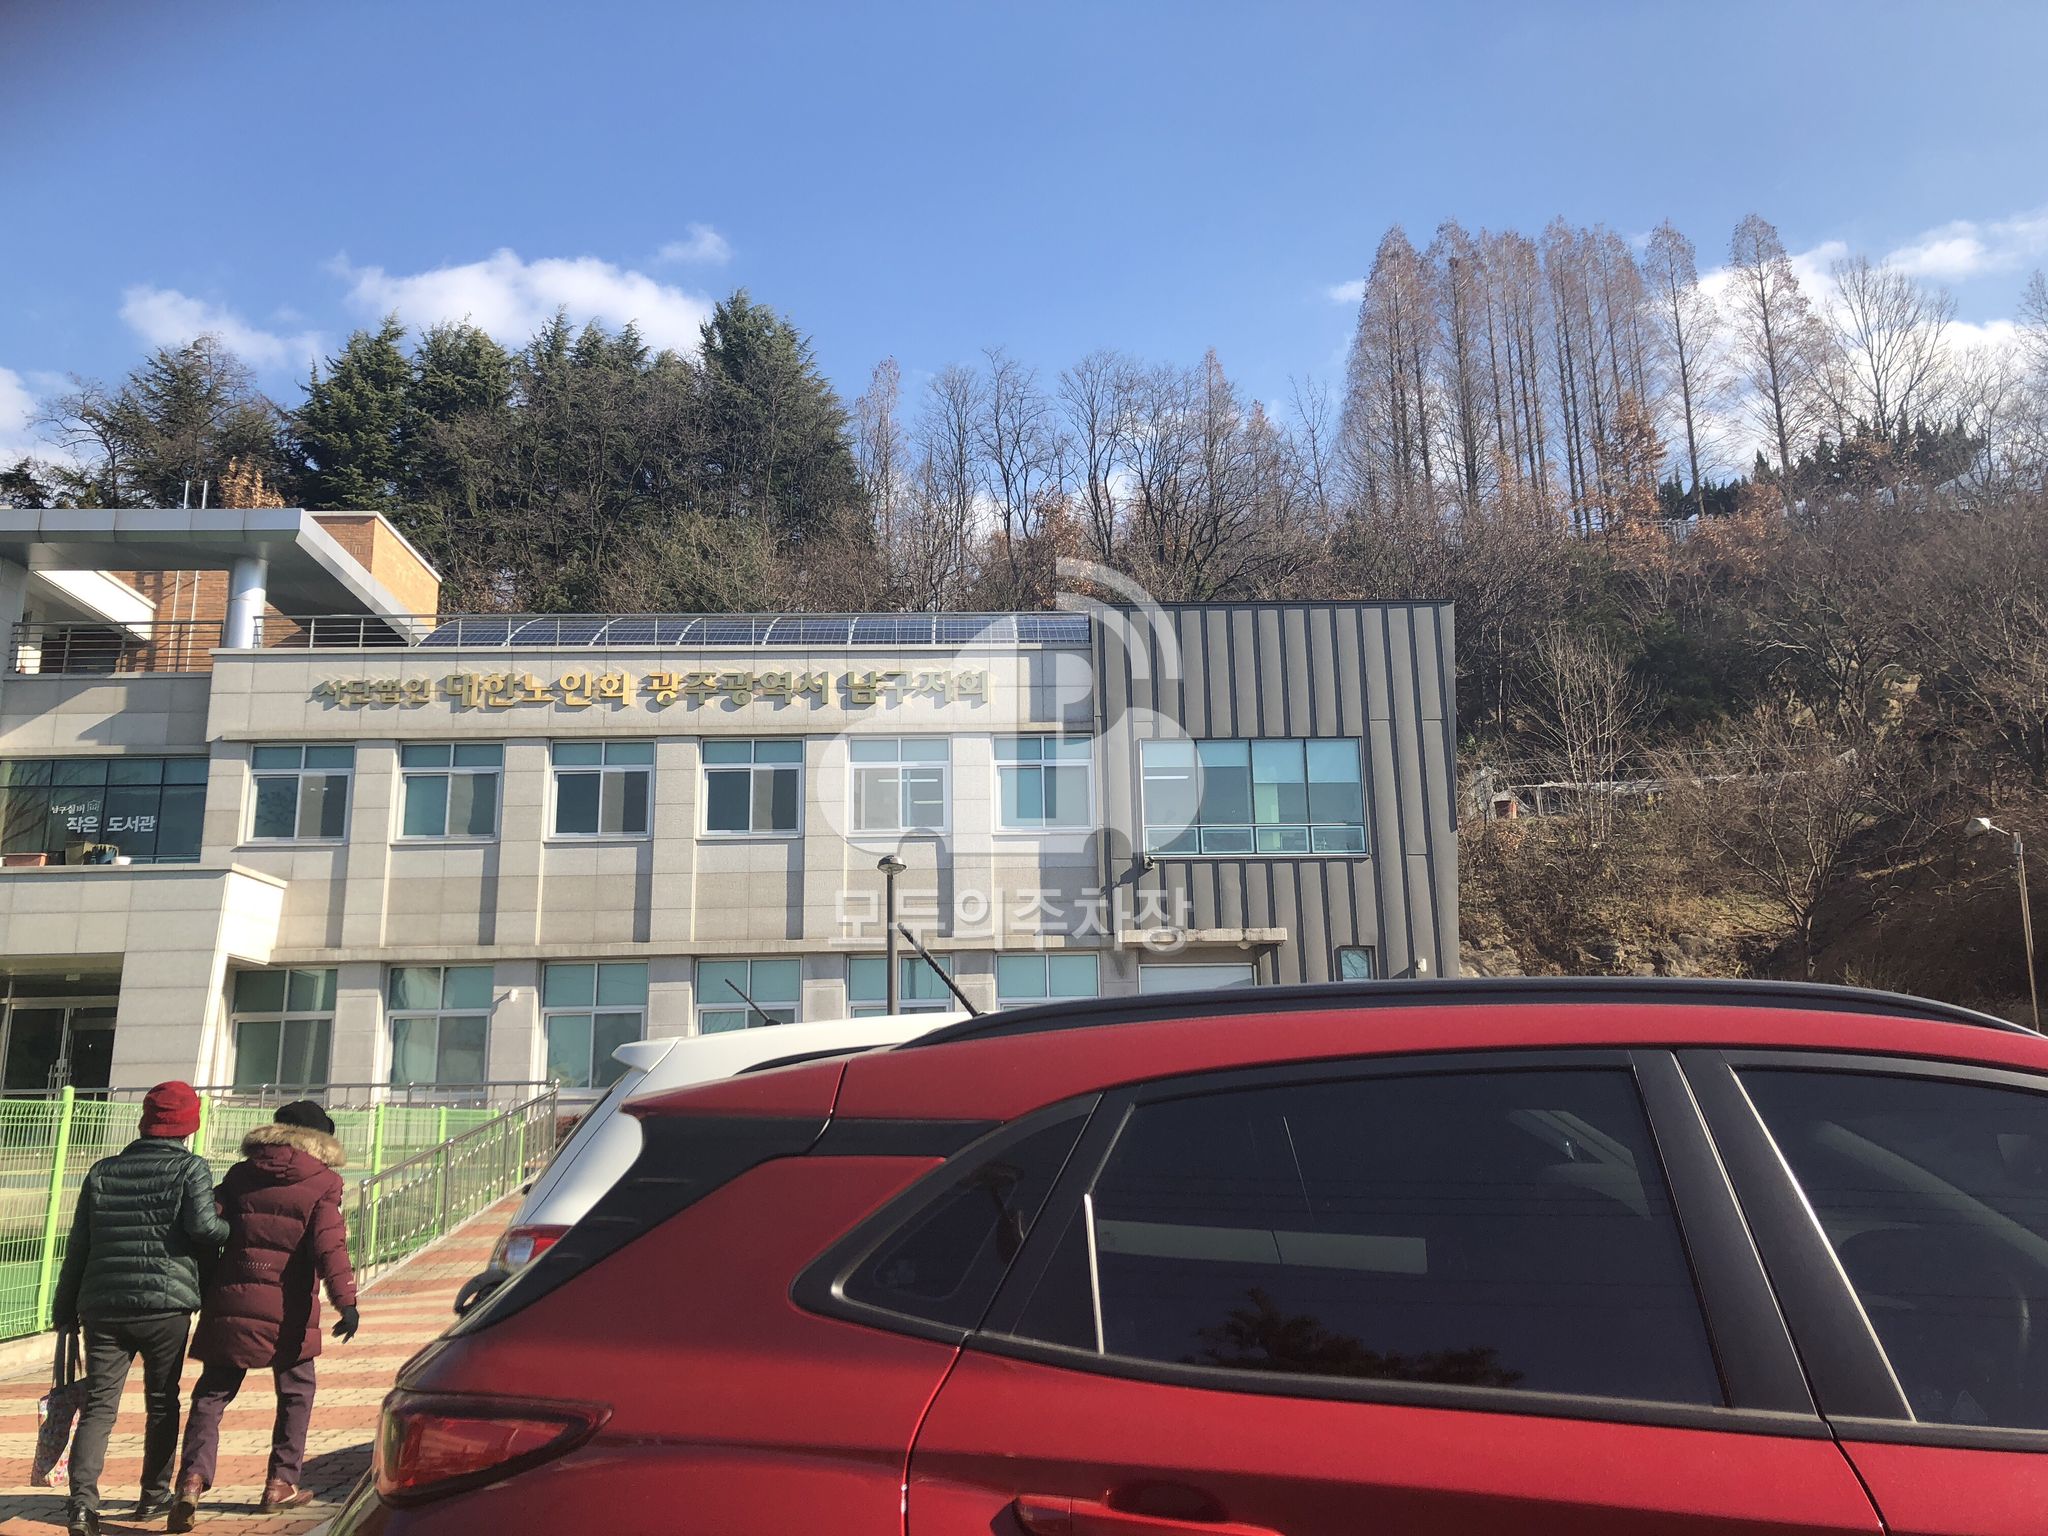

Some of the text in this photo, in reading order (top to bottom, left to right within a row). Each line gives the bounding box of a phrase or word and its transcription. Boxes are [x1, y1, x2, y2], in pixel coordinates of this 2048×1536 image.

[317, 670, 988, 707] 사단법인 대한노인회 광주광역시 남구지회
[51, 804, 86, 814] 남구실버
[66, 815, 156, 833] 작은 도서관
